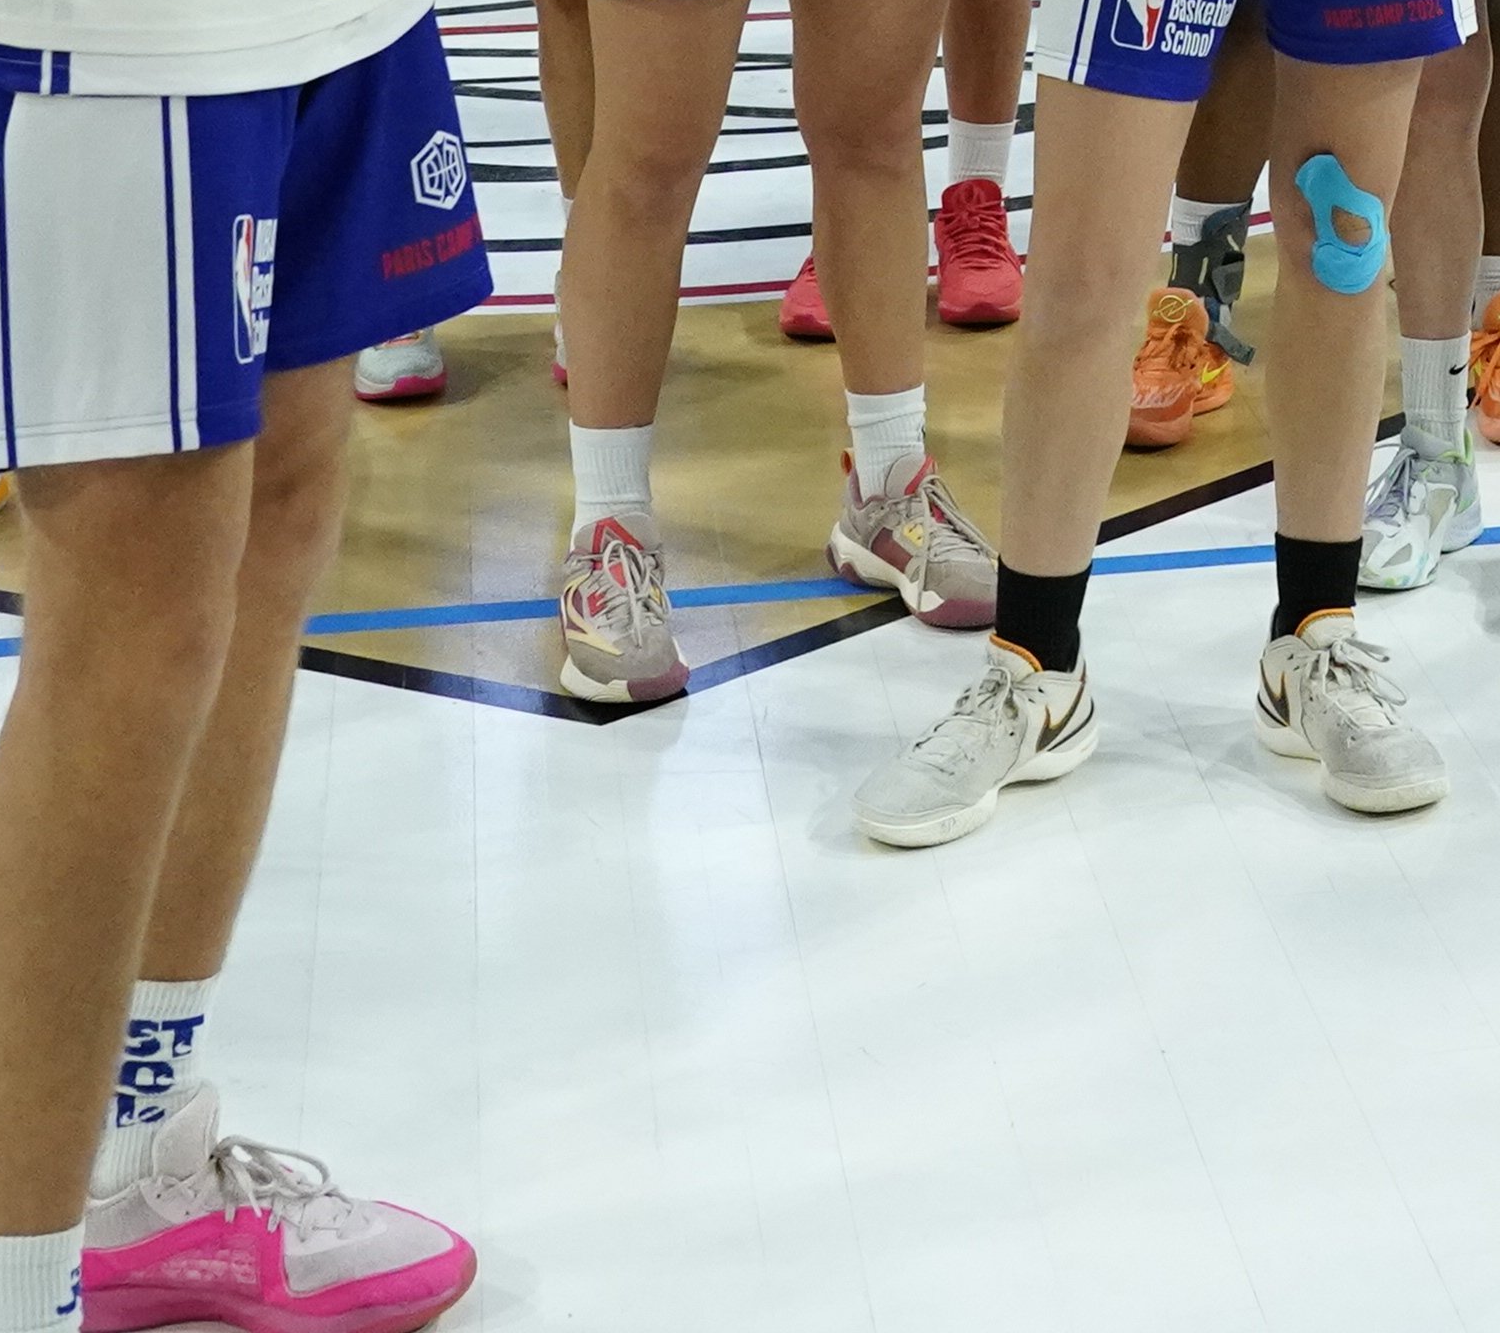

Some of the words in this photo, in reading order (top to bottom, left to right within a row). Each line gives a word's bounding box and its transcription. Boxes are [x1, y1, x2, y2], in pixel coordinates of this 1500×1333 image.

[1324, 8, 1363, 29] PARIS
[1367, 3, 1405, 27] CAMP
[1161, 21, 1215, 58] School
